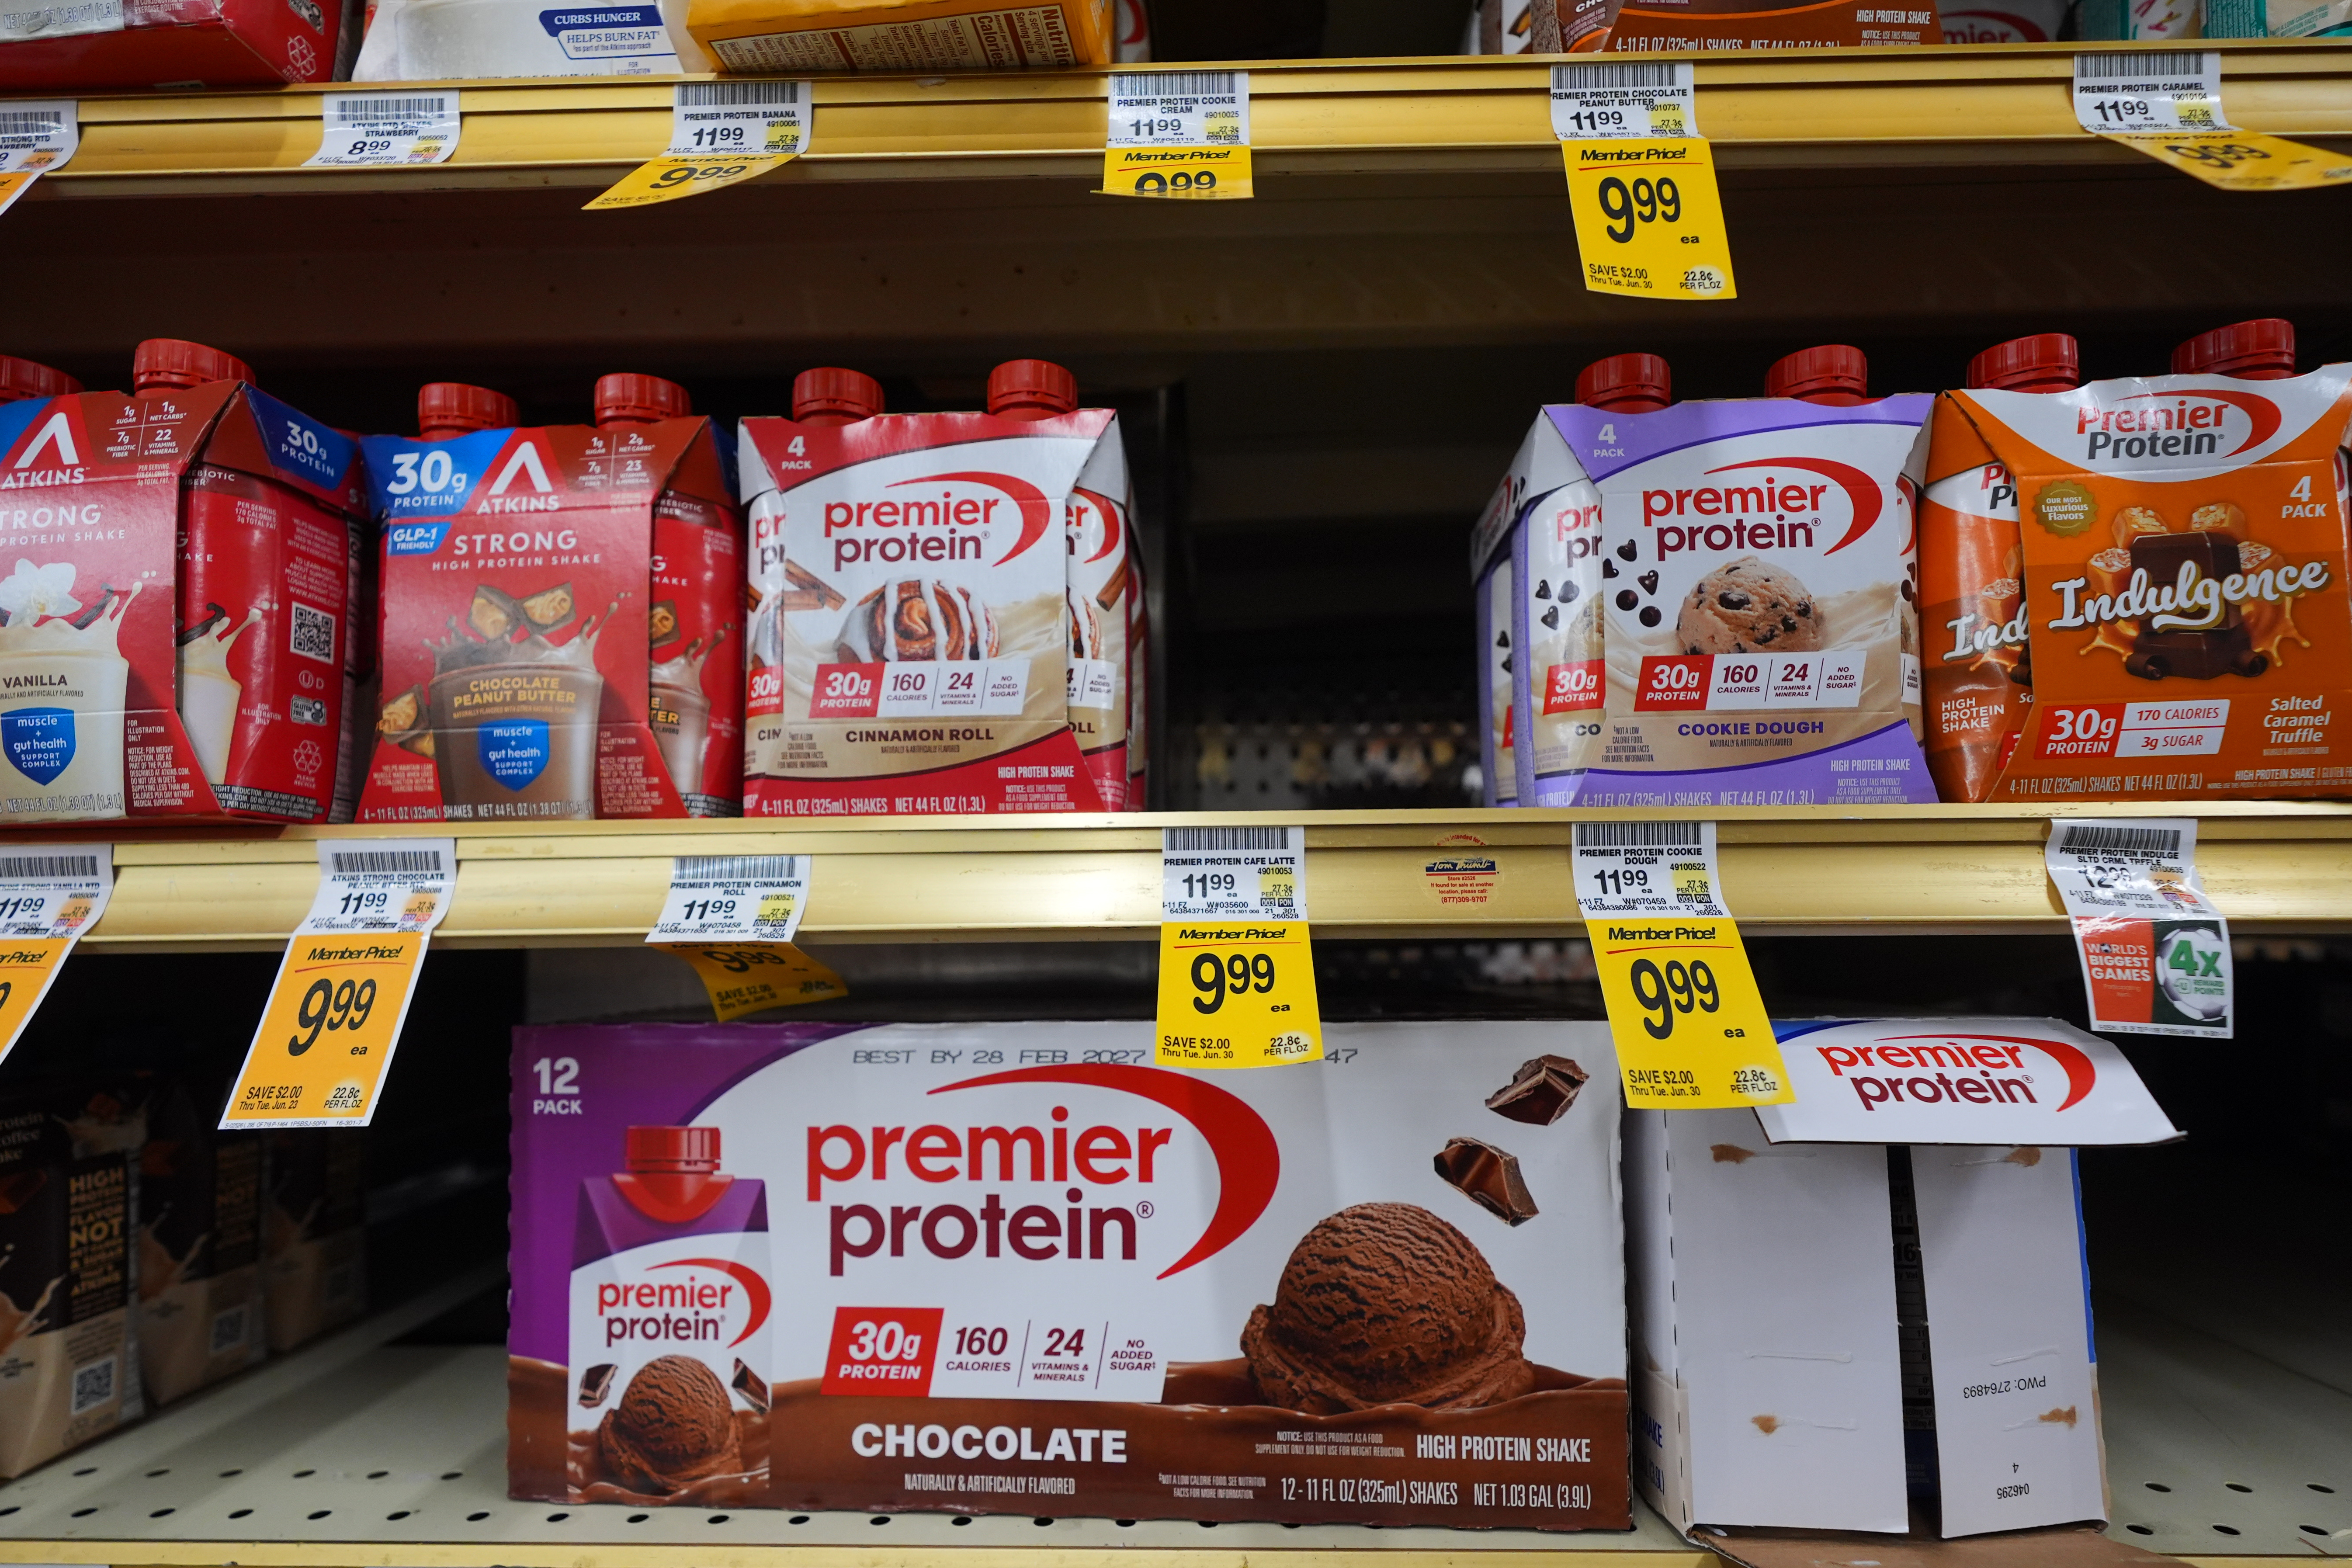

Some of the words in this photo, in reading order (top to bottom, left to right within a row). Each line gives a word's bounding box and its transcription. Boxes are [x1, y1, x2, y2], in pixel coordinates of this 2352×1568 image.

[554, 14, 592, 24] CURBS
[593, 12, 641, 23] HUNGER
[1856, 10, 1874, 22] HIGH
[1876, 10, 1906, 23] PROTEIN
[1908, 11, 1931, 24] SHAKE
[567, 34, 602, 43] HELPS
[605, 32, 635, 42] BURN
[1590, 90, 1629, 99] PROTEIN
[1632, 89, 1687, 97] CHOCOLATE
[2122, 84, 2159, 92] PROTEIN
[2162, 83, 2205, 91] CARAMEL
[1581, 149, 1645, 161] Member
[1646, 148, 1686, 160] Price!
[1589, 264, 1618, 277] SAVE
[1621, 267, 1648, 279] $2.00
[1590, 275, 1606, 284] Thru
[1609, 278, 1624, 286] Tue.
[1627, 279, 1642, 288] Jun.
[2077, 400, 2229, 434] Premier
[1598, 423, 1617, 444] 4
[1593, 448, 1625, 457] PACK
[1, 468, 85, 489] ATKINS
[386, 450, 467, 494] 30g
[2290, 475, 2312, 502] 4
[394, 495, 454, 507] PROTEIN
[477, 495, 560, 515] ATKINS
[1642, 477, 1827, 527] premier
[2042, 503, 2088, 513] Luxurious
[824, 491, 1000, 538] premier
[2048, 511, 2084, 521] Flavors
[2282, 503, 2327, 518] PACK
[0, 533, 66, 546] PROTEIN
[75, 529, 125, 540] SHAKE
[393, 527, 438, 542] GLP-1
[454, 529, 578, 555] STRONG
[433, 560, 469, 571] HIGH
[478, 557, 543, 568] PROTEIN
[551, 554, 600, 565] SHAKE
[2049, 560, 2328, 629] Indulgence
[1782, 663, 1808, 682] 24
[3, 675, 67, 688] VANILLA
[469, 677, 560, 693] CHOCOLATE
[825, 672, 871, 697] 30g
[454, 691, 513, 708] PEANUT
[517, 690, 576, 703] BUTTER
[2270, 695, 2323, 711] Salted
[17, 715, 57, 727] muscle
[2137, 710, 2160, 721] 170
[2165, 708, 2219, 720] CALORIES
[2264, 711, 2331, 728] Caramel
[1678, 722, 1750, 736] COOKIE
[1756, 721, 1824, 735] DOUGH
[2049, 709, 2116, 741] 30g
[846, 729, 944, 742] CINNAMON
[950, 728, 994, 740] ROLL
[2270, 728, 2323, 744] Truffle
[2046, 741, 2110, 755] PROTEIN
[998, 767, 1016, 778] HIGH
[1018, 766, 1049, 778] PROTEIN
[1051, 766, 1074, 777] SHAKE
[2089, 955, 2150, 967] BIGGEST
[2091, 968, 2151, 982] GAMES
[853, 1049, 916, 1065] BEST
[930, 1049, 963, 1065] BY
[972, 1049, 1004, 1065] 28
[1019, 1049, 1068, 1065] FEB
[1082, 1049, 1146, 1065] 2027
[1816, 1042, 2025, 1076] premier
[533, 1057, 580, 1094] 12
[533, 1099, 582, 1115] PACK
[806, 1106, 1173, 1201] premier
[598, 1276, 732, 1315] premier
[848, 1321, 921, 1360] 30g
[839, 1365, 921, 1380] PROTEIN
[851, 1423, 1128, 1463] CHOCOLATE
[1417, 1435, 1456, 1459] HIGH
[1462, 1436, 1530, 1461] PROTEIN
[1537, 1438, 1591, 1462] SHAKE
[905, 1474, 956, 1492] NATURALLY
[958, 1475, 964, 1492] &
[966, 1475, 1027, 1494] ARTIFICIALLY
[1028, 1477, 1075, 1495] FLAVORED
[1281, 1478, 1295, 1500] 12
[1306, 1478, 1318, 1501] 11
[1323, 1479, 1336, 1501] FL
[1339, 1480, 1356, 1502] OZ
[1358, 1479, 1407, 1505] (325mL)
[1410, 1481, 1457, 1505] SHAKES
[1474, 1483, 1496, 1506] NET
[1501, 1484, 1525, 1507] 1.03
[1529, 1485, 1554, 1507] GAL
[1557, 1484, 1591, 1510] (3.9L)
